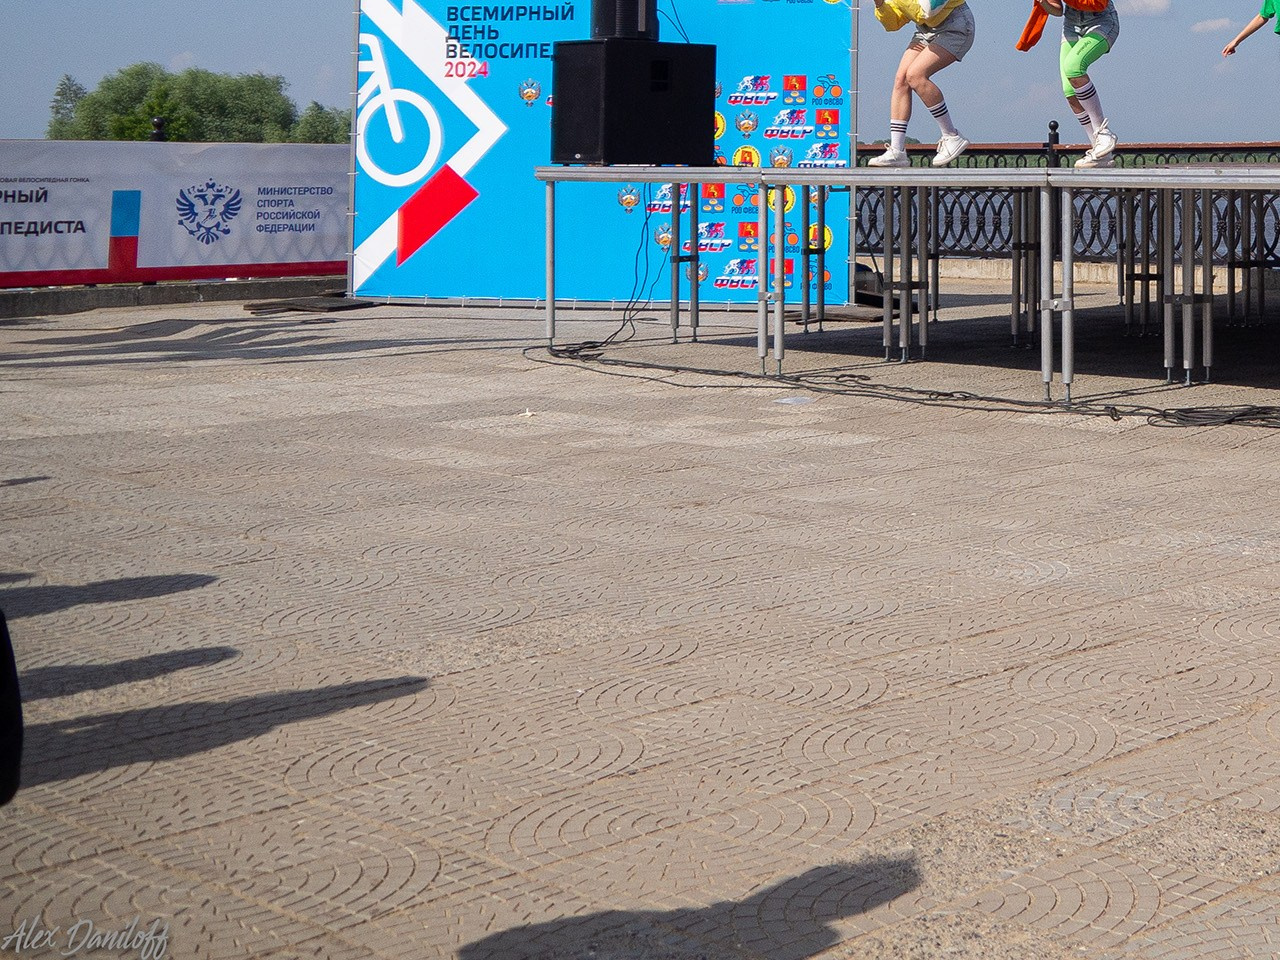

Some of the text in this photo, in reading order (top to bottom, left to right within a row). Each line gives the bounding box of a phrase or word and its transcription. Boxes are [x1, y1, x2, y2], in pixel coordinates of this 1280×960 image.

[447, 1, 575, 22] ВСЕМИРНЫЙ
[445, 25, 499, 42] ДЕНЬ
[446, 43, 556, 61] ВЕЛОСИПЕ
[444, 61, 489, 78] 2024
[257, 186, 333, 196] МИНИСТЕРСТВО
[257, 199, 295, 208] СПОРТА
[256, 209, 320, 220] РОССИЙСКОЙ
[0, 221, 86, 237] ПЕДИСТА
[256, 223, 315, 234] ФЕДЕРАЦИИ
